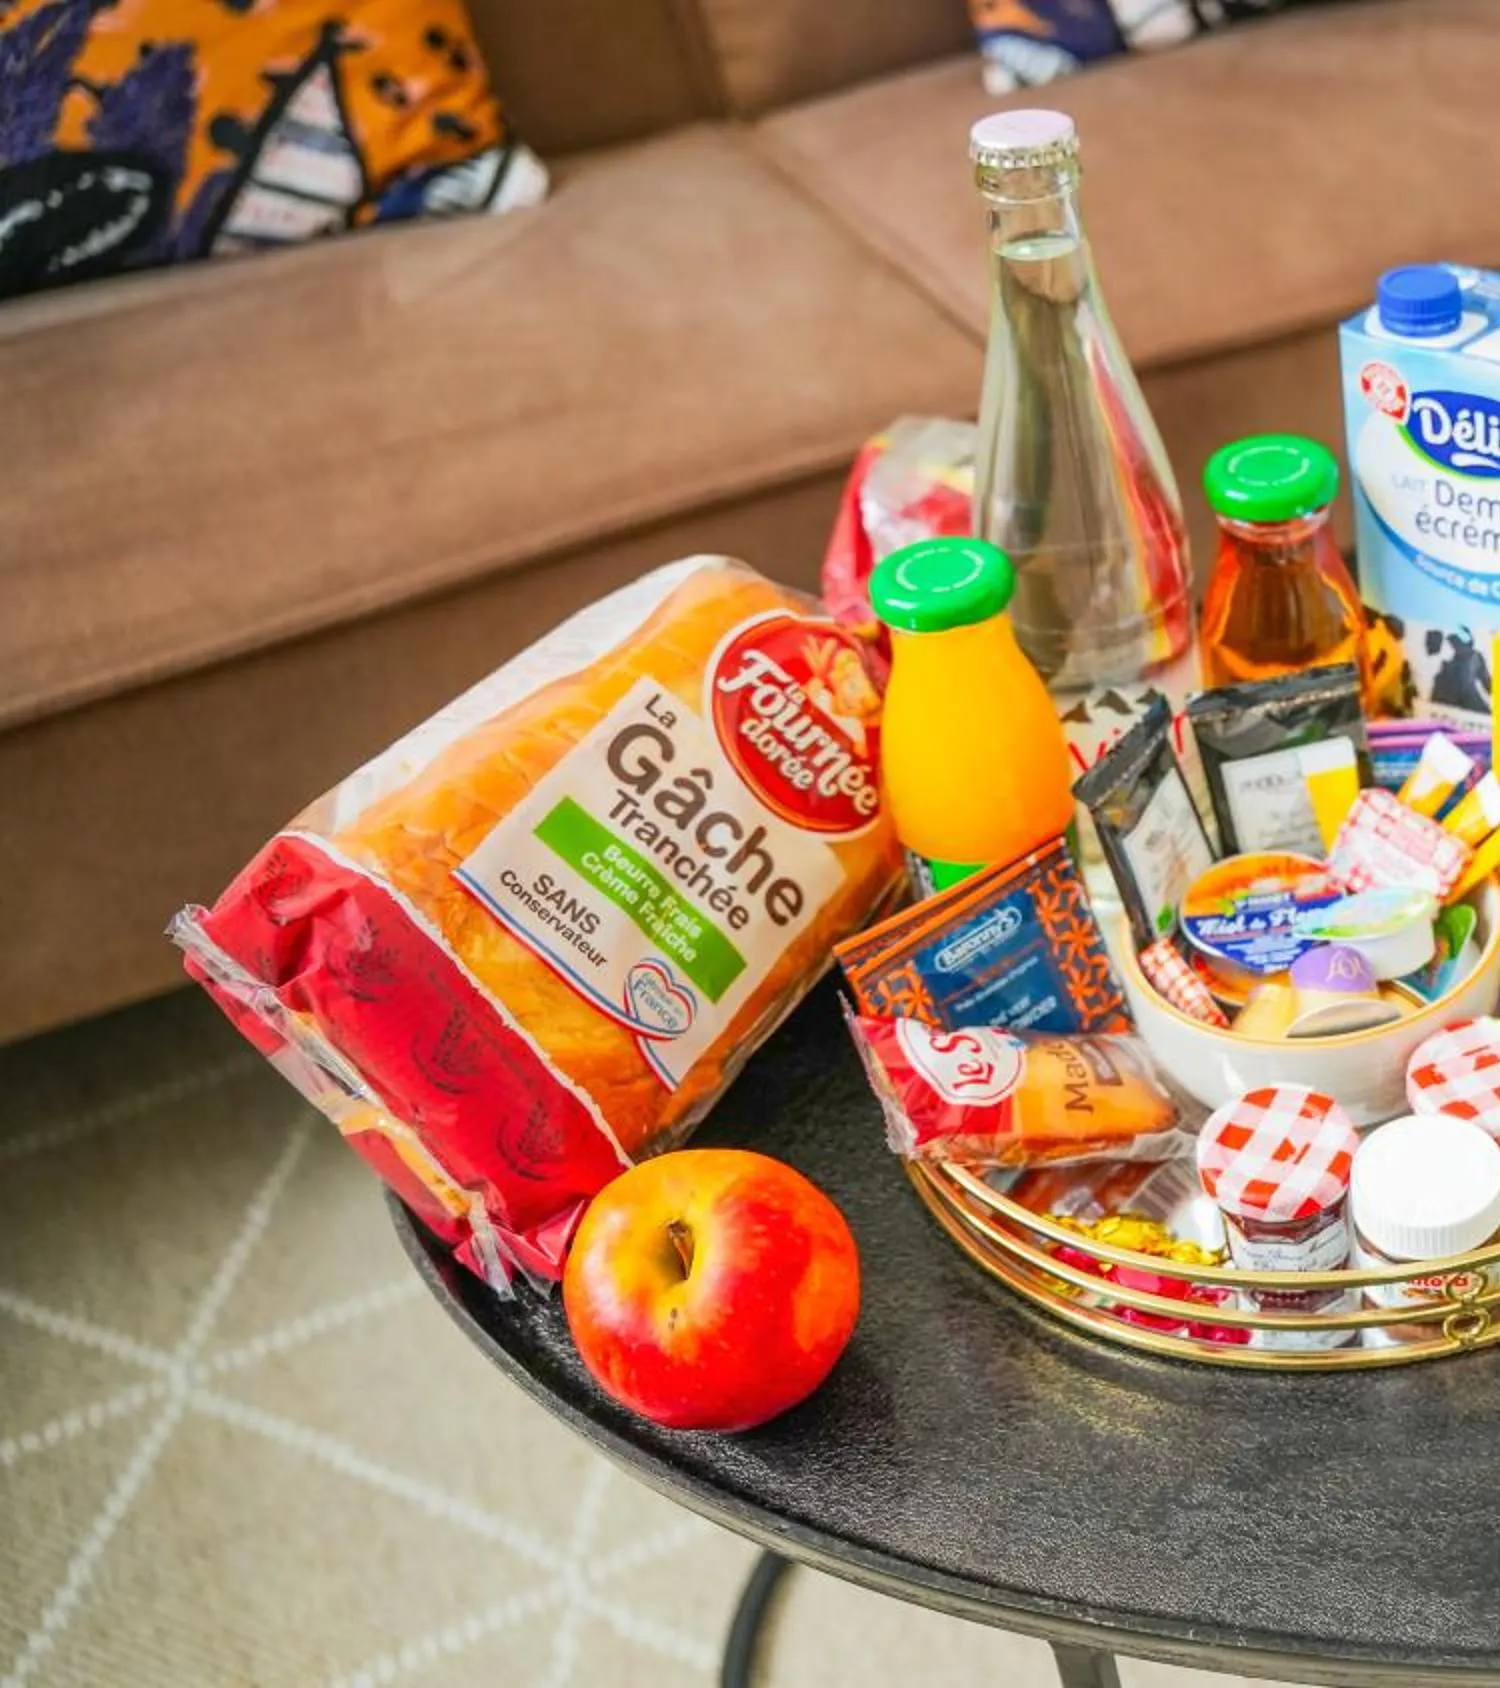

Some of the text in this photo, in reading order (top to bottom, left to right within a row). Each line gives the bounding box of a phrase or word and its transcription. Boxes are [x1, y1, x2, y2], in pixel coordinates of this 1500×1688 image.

[643, 693, 678, 730] La
[717, 648, 878, 815] Fournée
[739, 717, 815, 790] dorée
[606, 723, 804, 926] Gâche
[608, 788, 750, 931] Tranchée
[499, 868, 608, 969] Conservateur
[531, 873, 601, 936] SANS
[580, 851, 640, 905] Crème
[602, 843, 703, 938] Beurre Frais
[952, 1062, 996, 1092] Le
